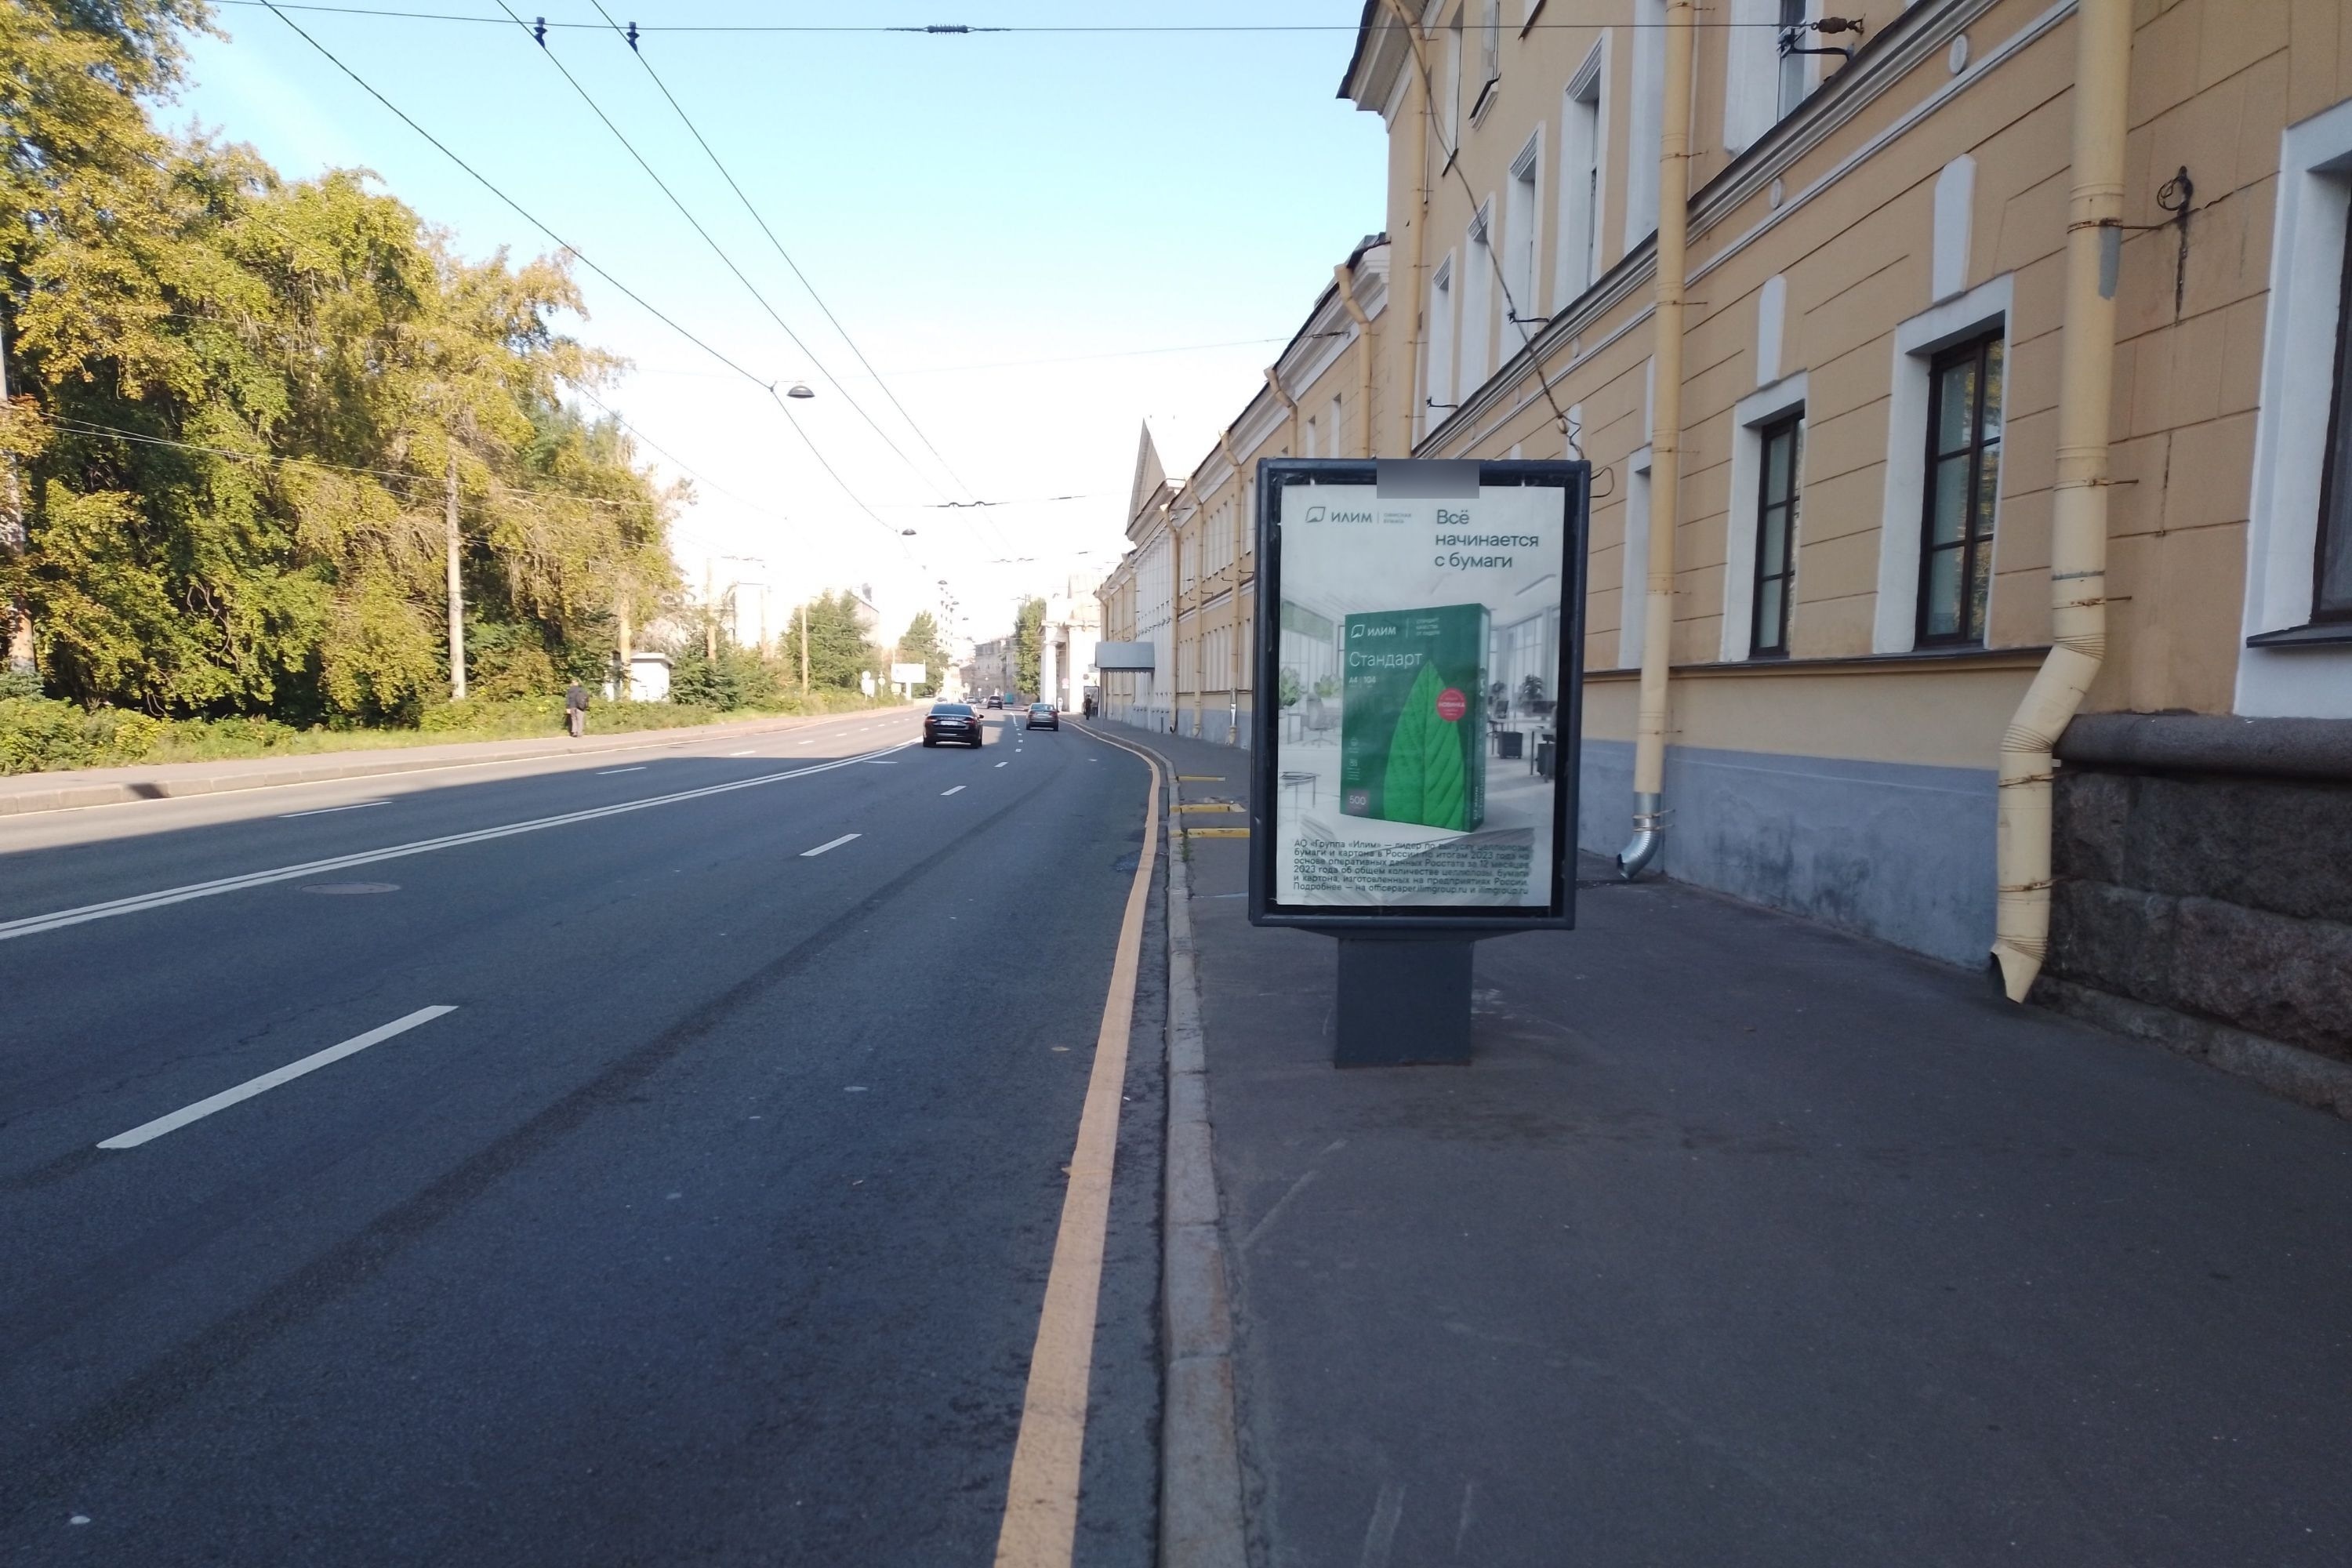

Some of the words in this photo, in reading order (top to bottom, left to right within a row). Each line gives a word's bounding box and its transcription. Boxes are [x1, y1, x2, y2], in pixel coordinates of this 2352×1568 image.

[1330, 512, 1372, 523] ИЛИМ
[1436, 509, 1469, 524] Всё
[1436, 533, 1539, 547] начинается
[1435, 555, 1445, 568] с
[1449, 552, 1513, 569] бумаги
[1367, 626, 1396, 637] ИЛИМ
[1349, 652, 1423, 669] Стандарт
[1349, 795, 1367, 805] 500
[1294, 839, 1308, 848] АО
[1310, 839, 1345, 849] «Группа
[1294, 848, 1327, 857] бумаги
[1294, 865, 1316, 873] 2023
[1341, 866, 1352, 874] об
[1355, 866, 1386, 874] общем
[1294, 882, 1342, 891] Подробнее
